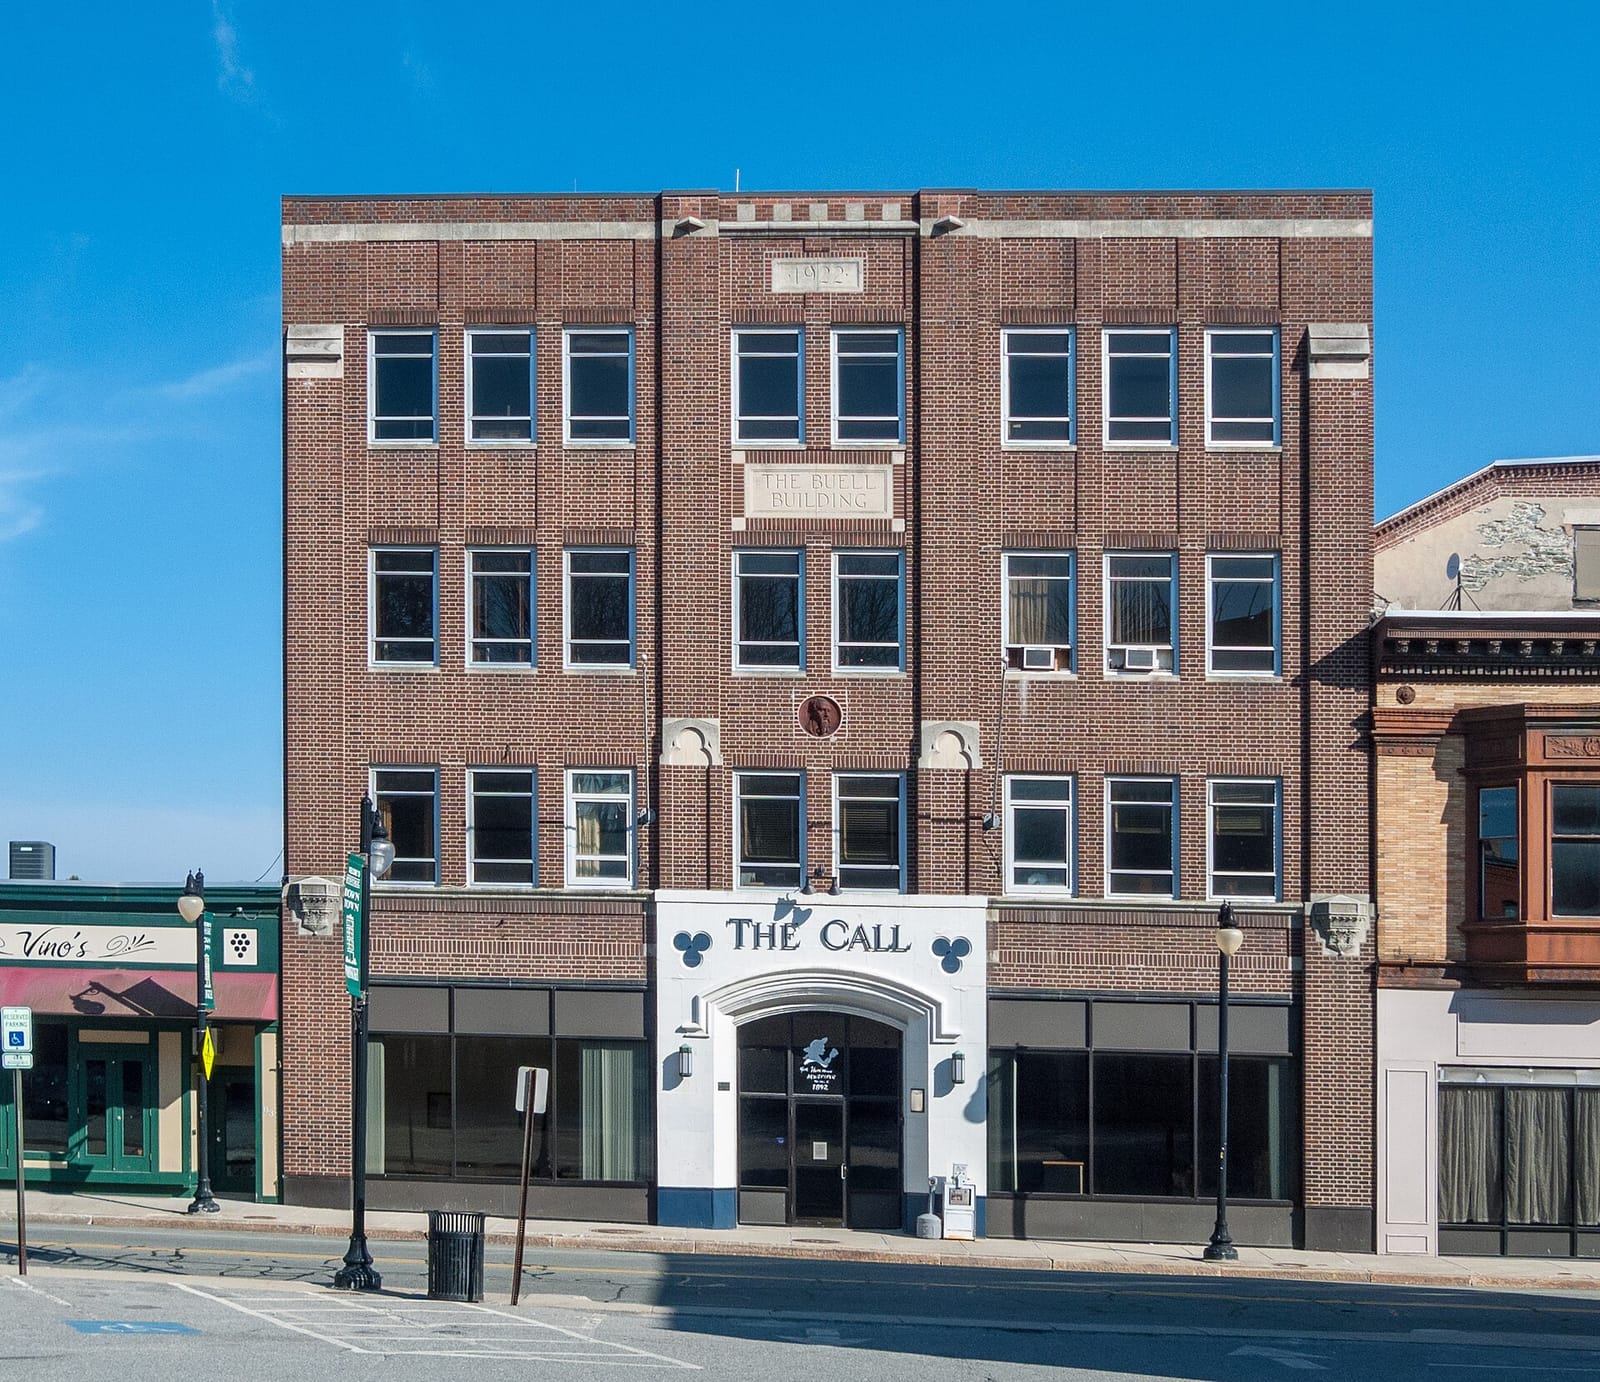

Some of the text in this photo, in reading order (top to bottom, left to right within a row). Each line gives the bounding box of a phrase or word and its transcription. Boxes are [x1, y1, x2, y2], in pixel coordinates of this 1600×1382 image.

[762, 473, 877, 490] THE BUELL
[771, 492, 867, 508] BUILDING
[16, 927, 90, 958] Vino's
[726, 918, 912, 952] THE CALL
